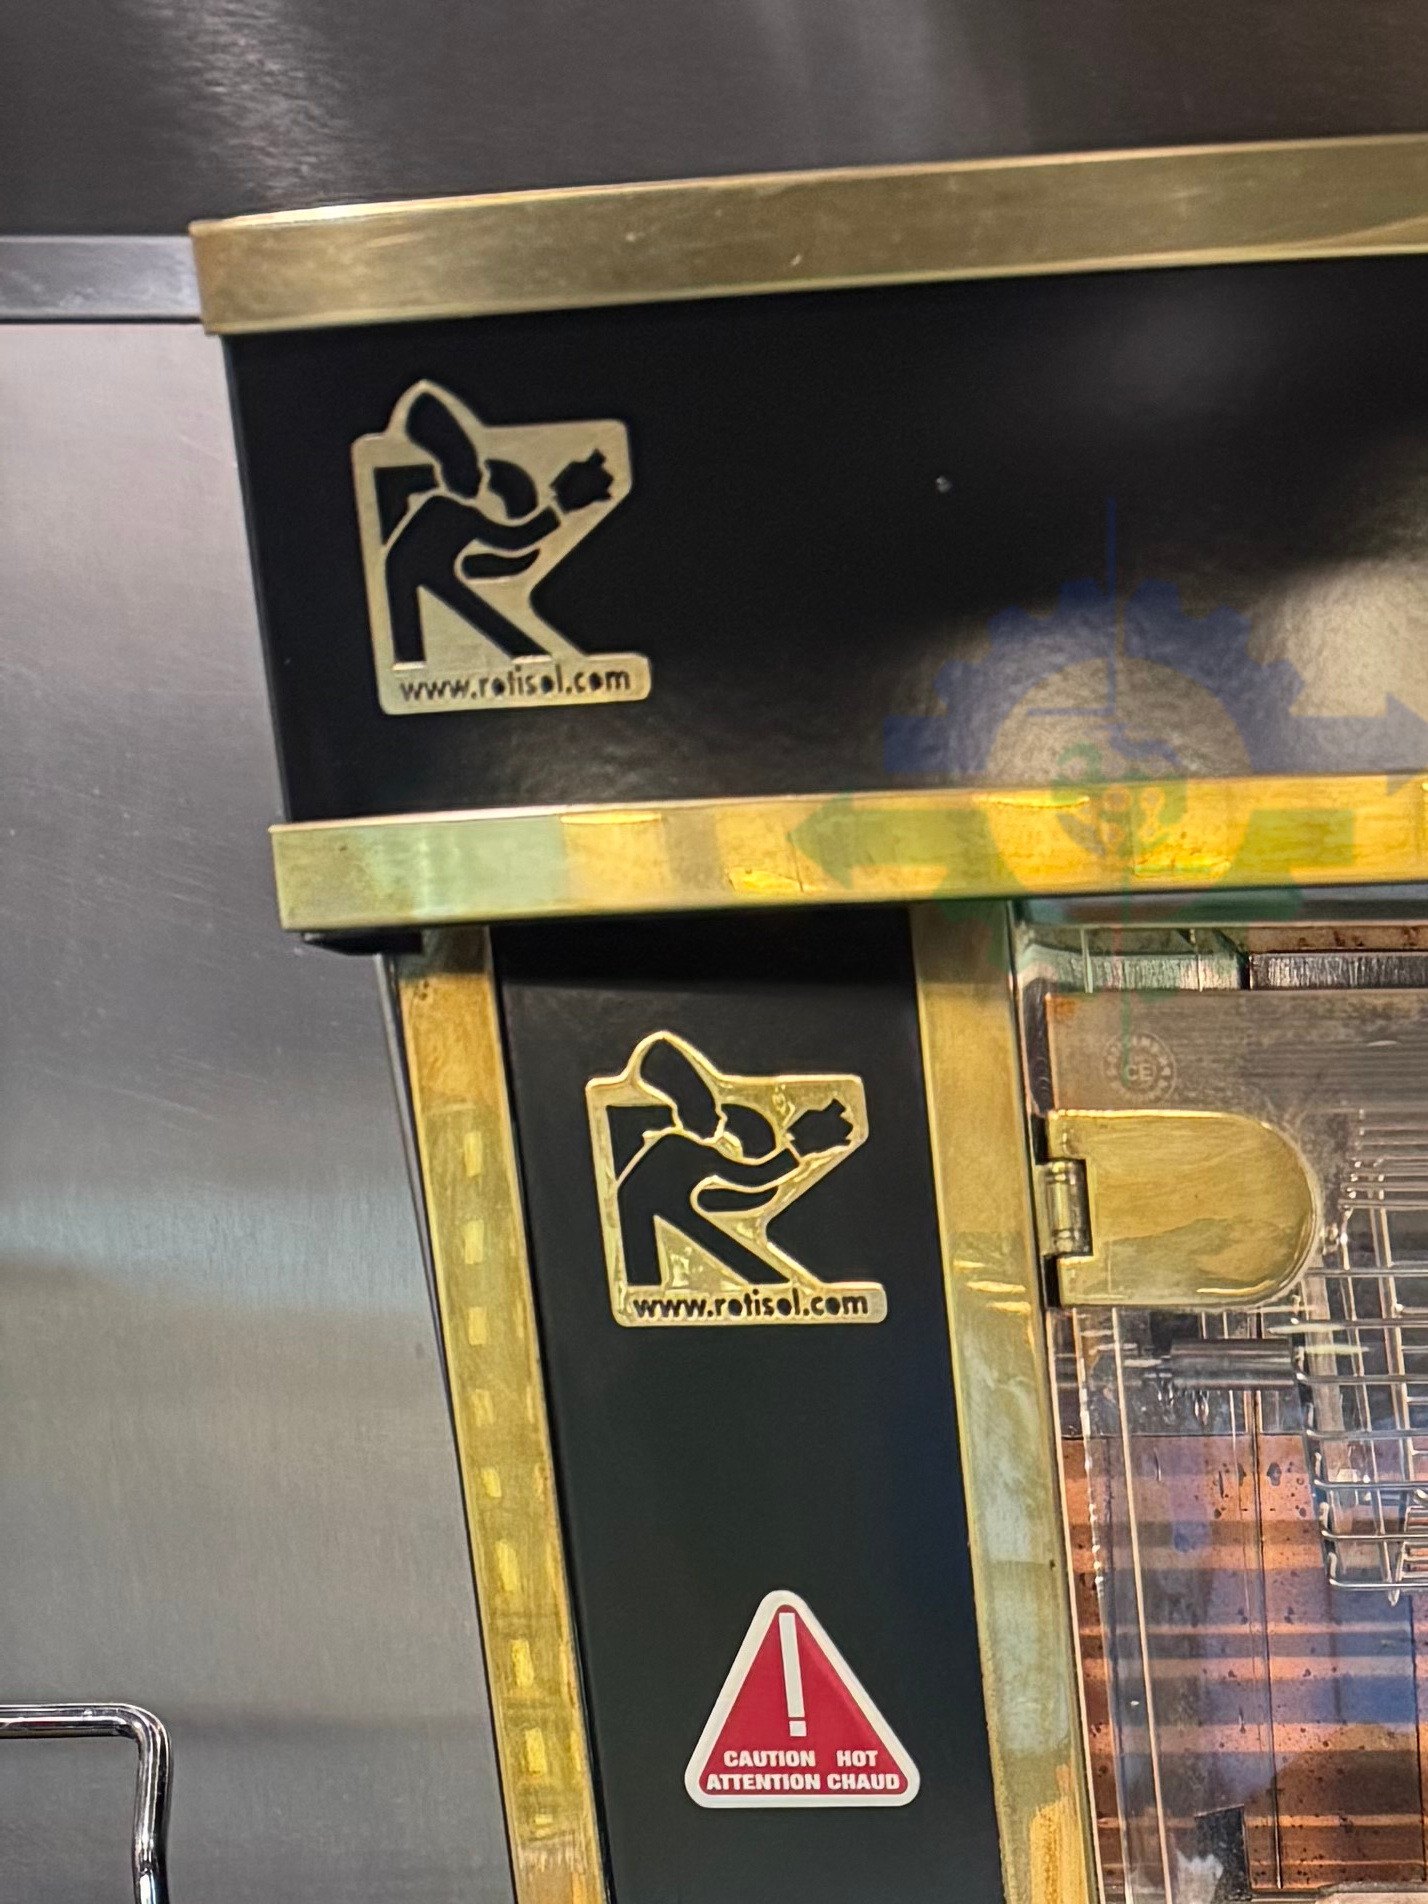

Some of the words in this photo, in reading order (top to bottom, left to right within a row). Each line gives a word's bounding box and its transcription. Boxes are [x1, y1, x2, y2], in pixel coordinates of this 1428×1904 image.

[723, 1750, 816, 1767] CAUTION
[836, 1750, 878, 1767] HOT
[706, 1773, 821, 1790] ATTENTION
[826, 1773, 900, 1790] CHAUD
